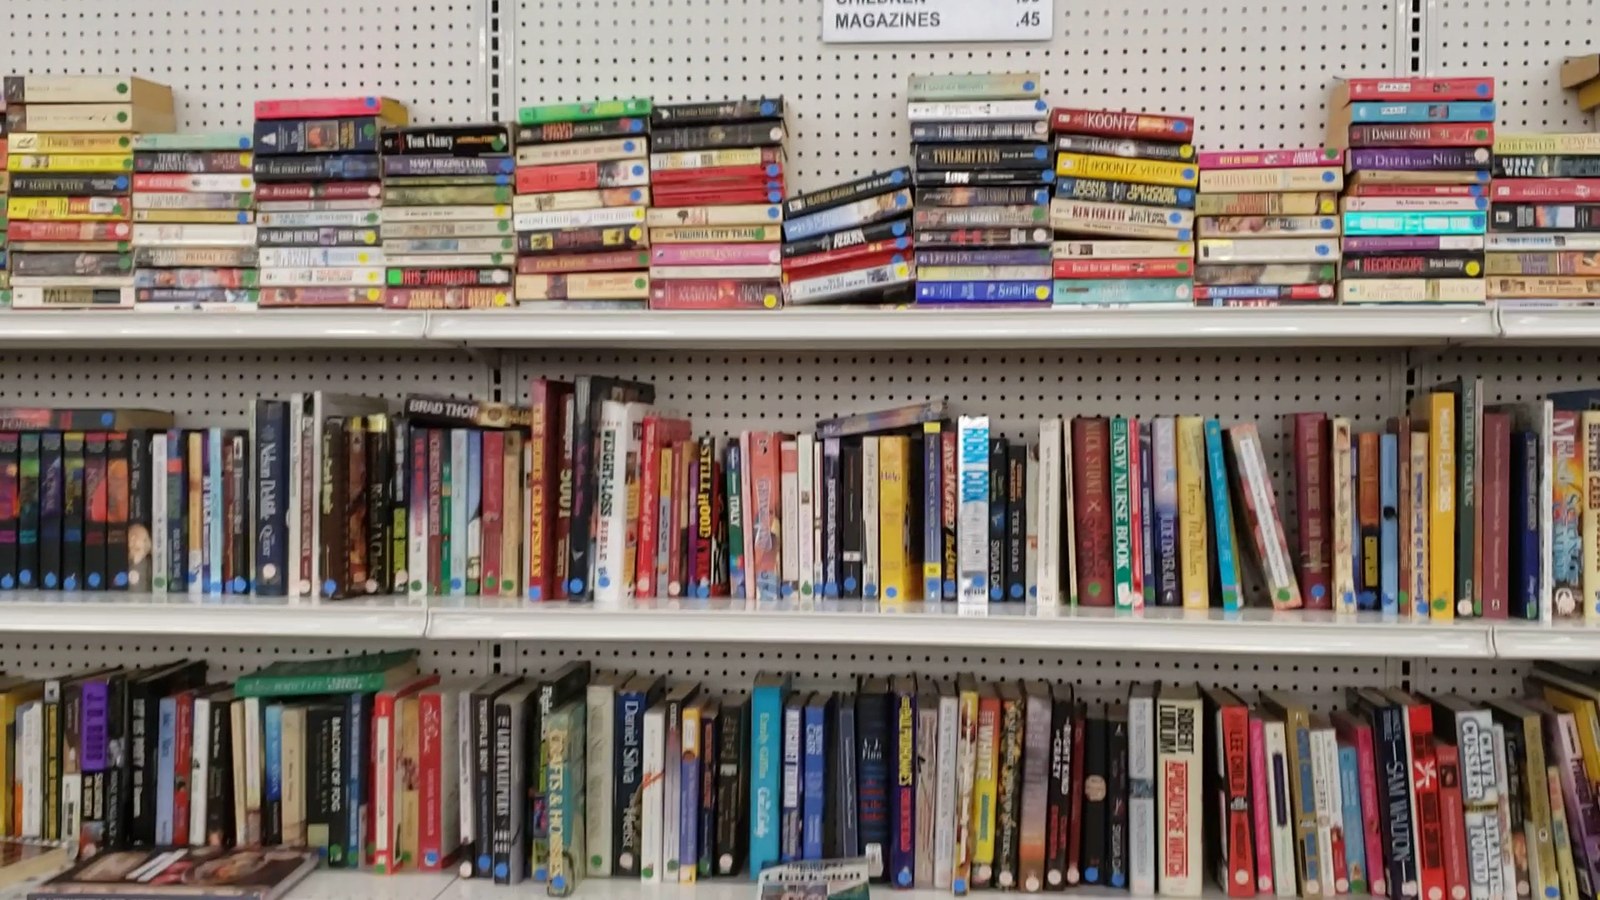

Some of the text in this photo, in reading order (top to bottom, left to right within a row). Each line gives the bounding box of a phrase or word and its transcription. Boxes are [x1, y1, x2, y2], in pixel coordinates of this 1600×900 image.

[835, 11, 1040, 29] MAGAZINES .45
[406, 135, 425, 149] Tom
[426, 133, 453, 150] Clancy
[1088, 114, 1137, 131] KOONTZ
[1372, 128, 1408, 140] DANIELLE
[933, 149, 976, 164] TWILIGHT
[1093, 161, 1137, 174] KOONTZ
[1375, 154, 1411, 166] DEEPER
[1433, 152, 1461, 166] NEED
[1072, 206, 1089, 218] KEN
[674, 231, 709, 240] VIRGINIA
[401, 269, 421, 285] RIS
[1364, 257, 1425, 272] NECROSCOPE
[409, 399, 479, 419] BRAD THOR
[260, 443, 276, 479] Nelson
[1086, 422, 1101, 495] NICK STONE
[1464, 454, 1473, 506] COOKING
[260, 480, 276, 521] DeMille
[600, 430, 615, 561] WEIGHT-LOSS BIBLE
[697, 446, 711, 538] STILL HOOD
[729, 496, 740, 528] ITALY
[1113, 434, 1129, 569] NEW NURSE BOOK
[532, 485, 543, 577] CRAFTSMAN
[479, 699, 488, 773] TRUFFLE BOY
[1159, 704, 1176, 754] LUDLUM
[1177, 708, 1194, 754] ROBERT
[331, 716, 340, 812] BALCONY OF FOG
[496, 729, 510, 816] LIGHTKEEPERS
[622, 700, 639, 848] Daniel Silva Heist
[862, 750, 882, 761] Finn
[977, 725, 994, 781] WHITE
[1052, 738, 1061, 780] CRAZY
[1229, 730, 1246, 791] LEE CHILD
[1462, 720, 1484, 800] CUSSLER
[1479, 732, 1495, 786] CLIVE
[549, 728, 566, 878] CRAFTS & HOBBIES
[1061, 766, 1069, 795] KIND
[1386, 762, 1410, 862] SAM WALTON
[1469, 827, 1489, 883] FOUND
